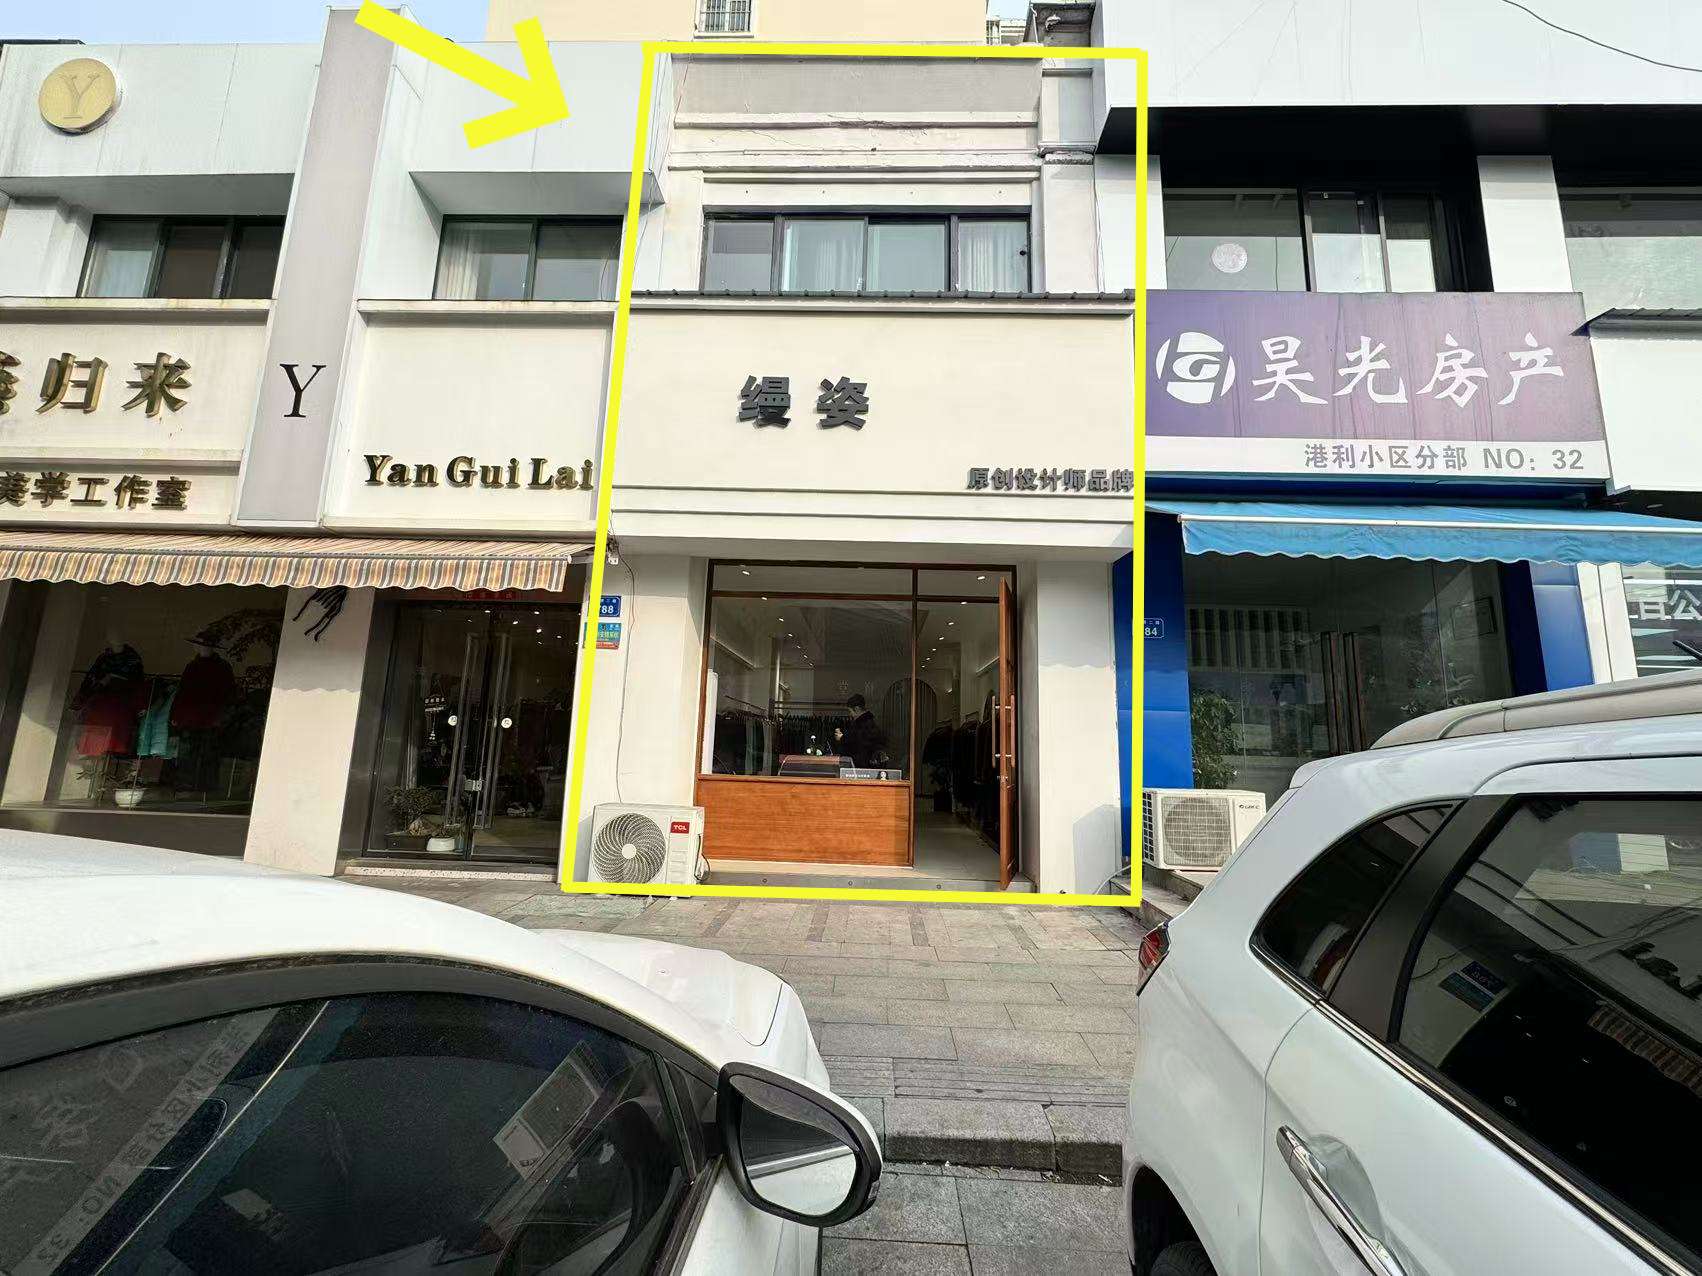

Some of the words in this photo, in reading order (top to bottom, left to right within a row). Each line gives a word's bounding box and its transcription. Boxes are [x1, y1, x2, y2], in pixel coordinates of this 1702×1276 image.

[56, 72, 101, 119] Y
[280, 363, 327, 418] Y
[1252, 332, 1564, 408] 昊光房产
[738, 374, 870, 431] 缦姿
[1303, 443, 1468, 471] 港利小区分部
[1552, 449, 1585, 471] 32
